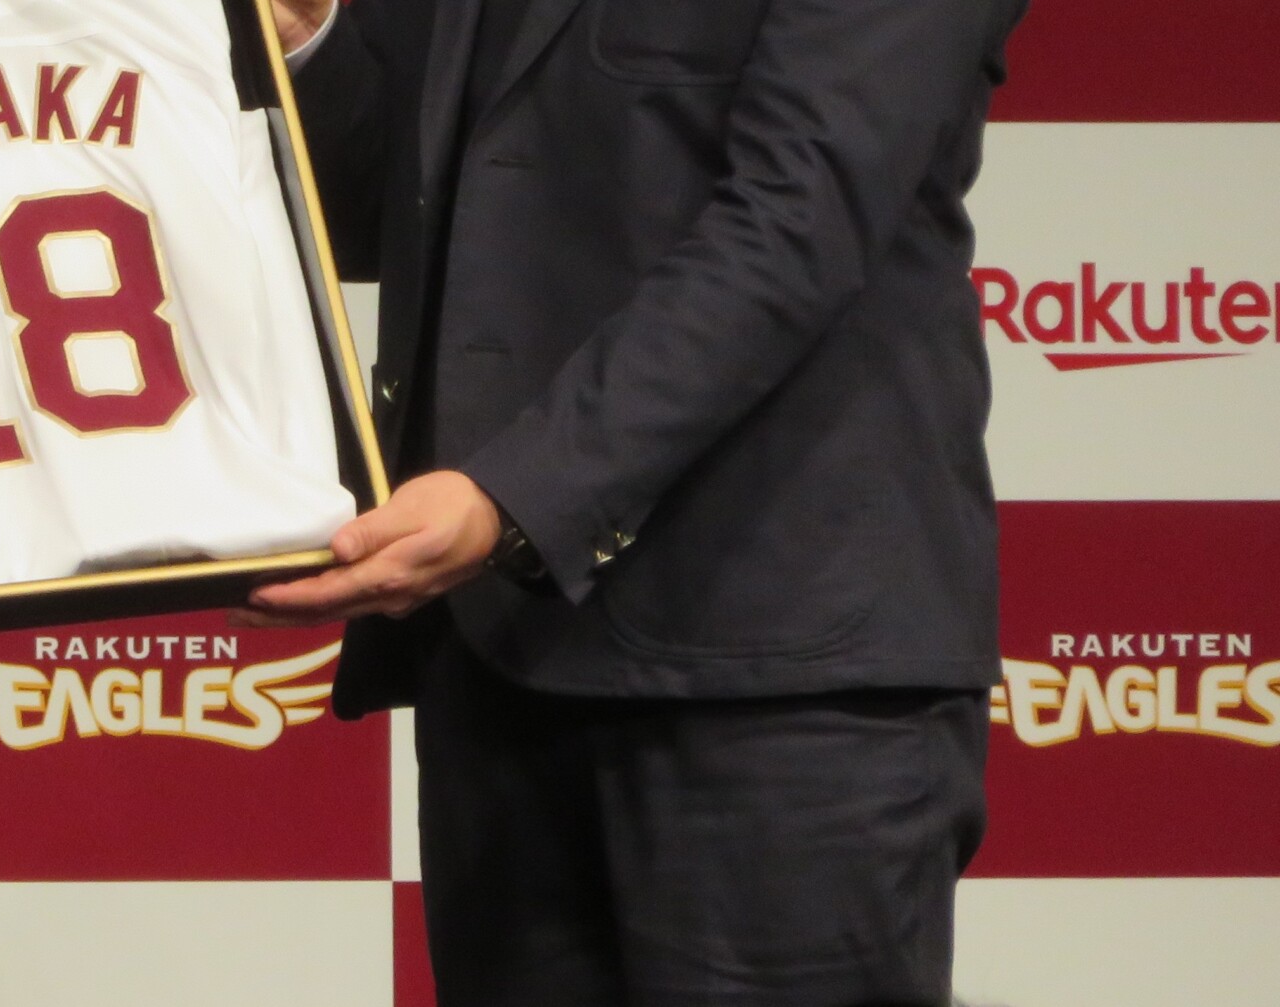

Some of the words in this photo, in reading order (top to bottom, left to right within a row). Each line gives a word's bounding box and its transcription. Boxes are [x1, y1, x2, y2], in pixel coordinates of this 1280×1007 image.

[968, 262, 1280, 346] Rakute
[34, 635, 239, 661] RAKUTEN
[1050, 633, 1253, 658] RAKUTEN
